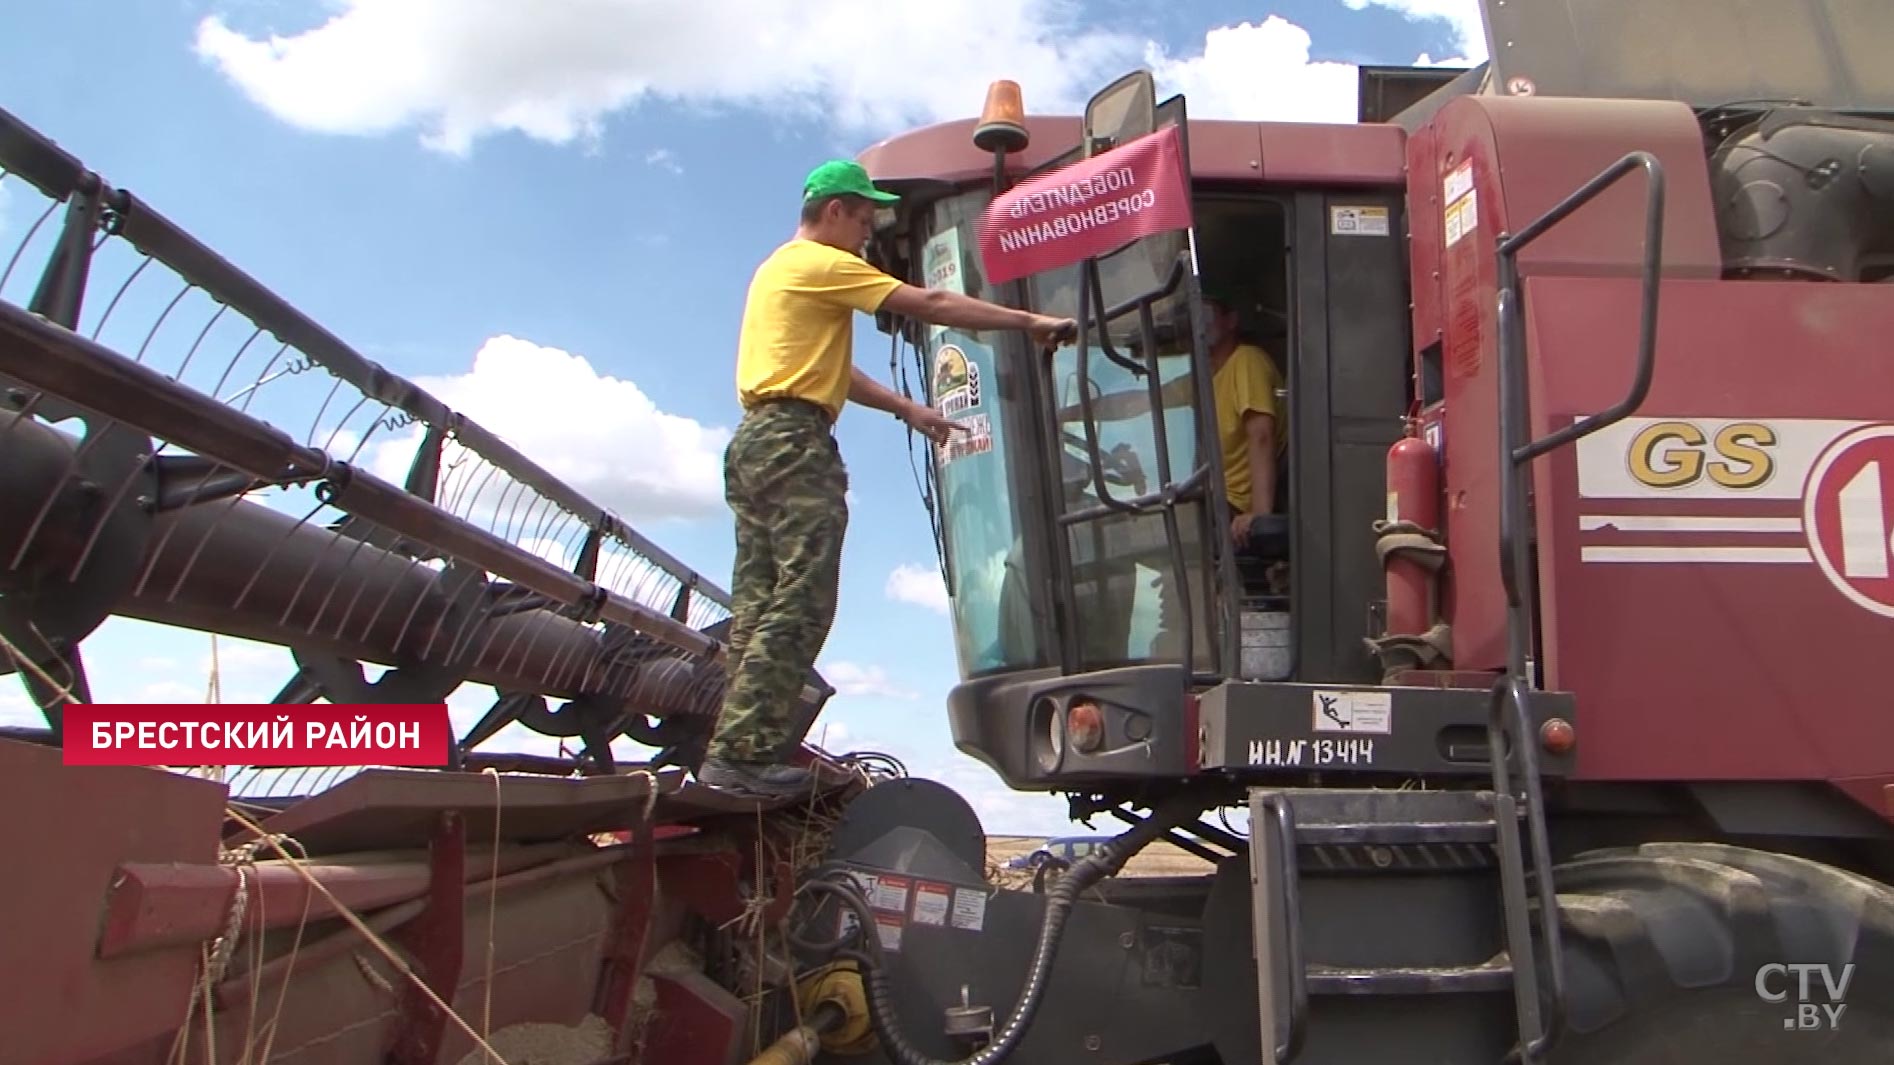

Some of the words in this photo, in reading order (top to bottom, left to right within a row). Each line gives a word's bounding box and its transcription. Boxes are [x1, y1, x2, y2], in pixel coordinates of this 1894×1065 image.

[1626, 421, 1778, 489] GS
[1838, 460, 1894, 578] 1
[1312, 738, 1373, 765] 13414
